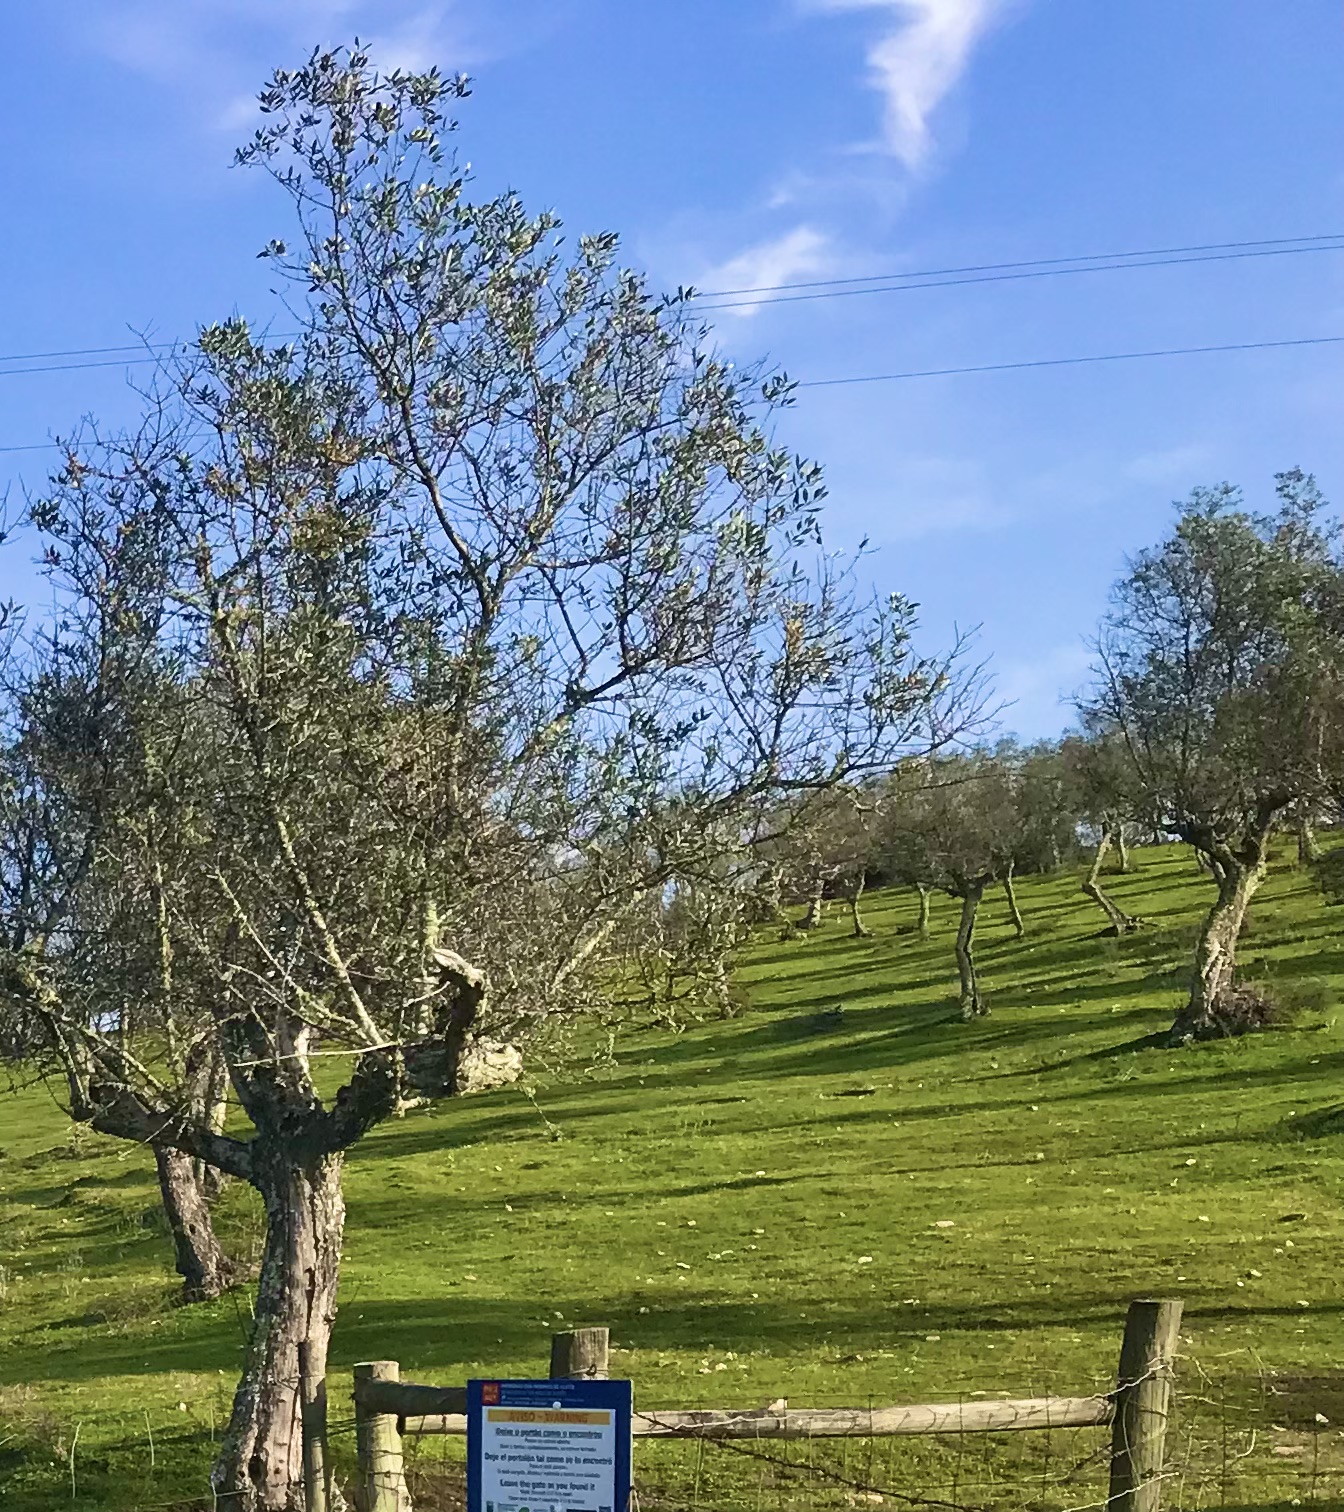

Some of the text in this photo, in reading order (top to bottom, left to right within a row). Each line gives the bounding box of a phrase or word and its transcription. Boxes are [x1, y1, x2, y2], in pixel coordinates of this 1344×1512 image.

[545, 1412, 588, 1423] WARNING
[485, 1452, 499, 1462] Deje
[500, 1479, 518, 1487] Leave
[532, 1482, 546, 1490] gate
[570, 1482, 588, 1490] found
